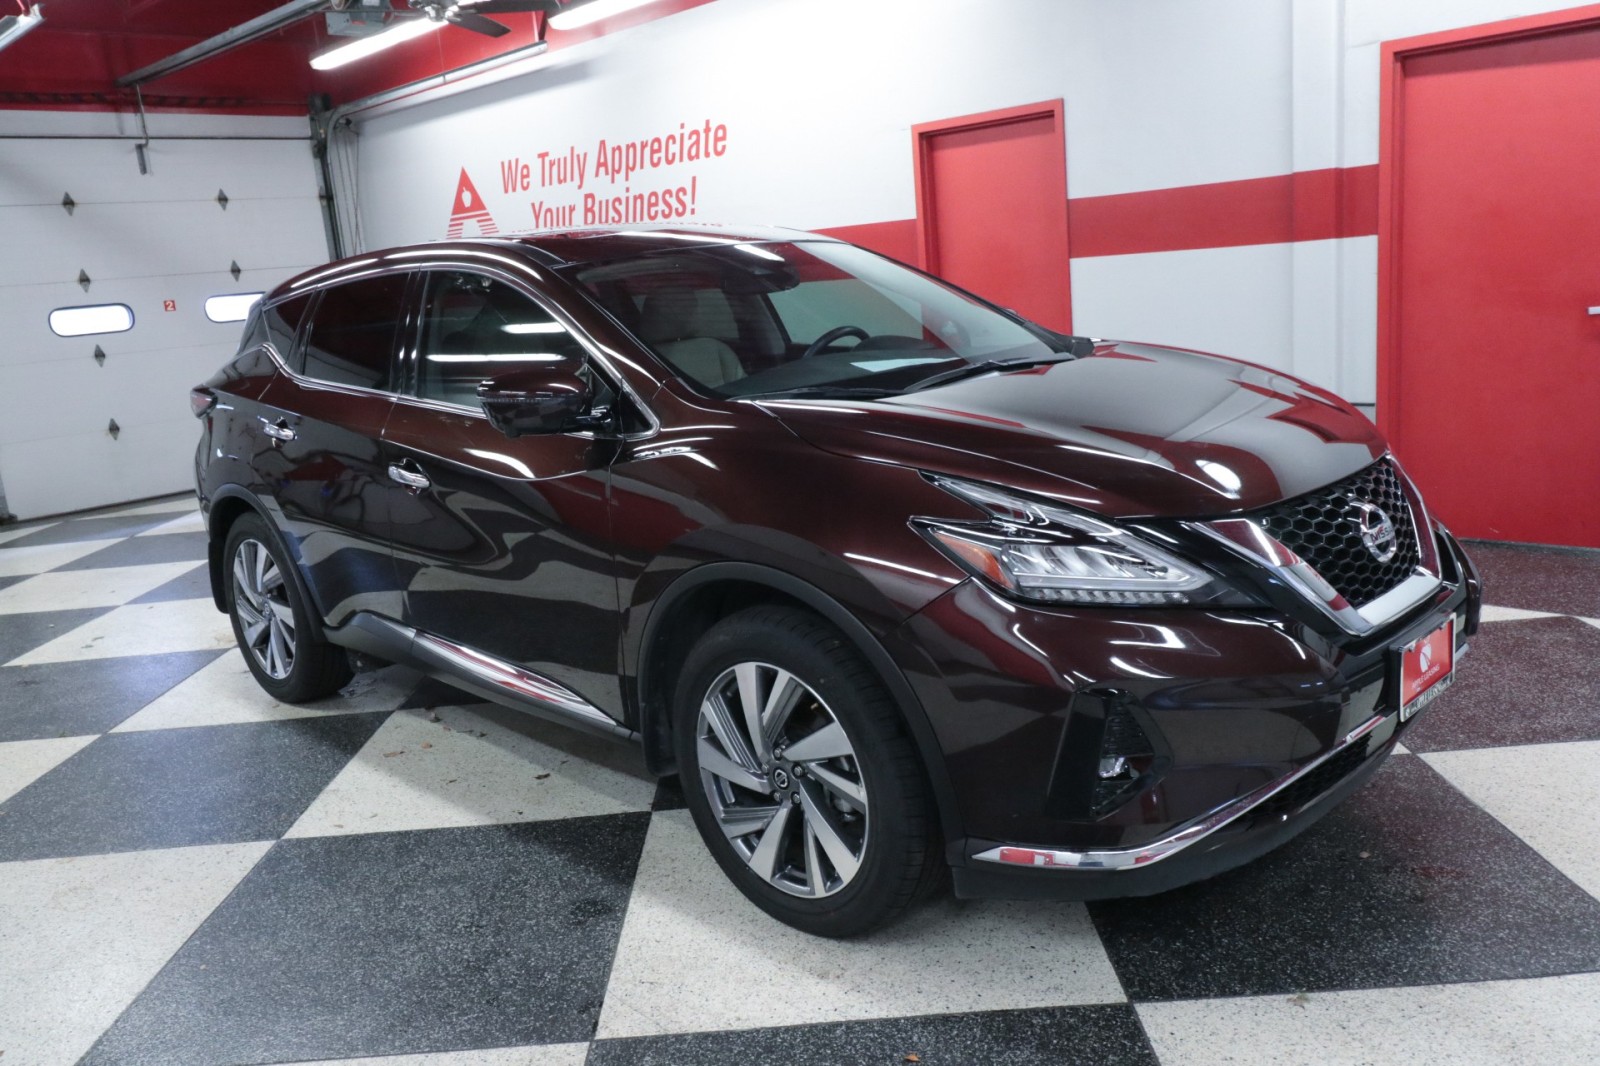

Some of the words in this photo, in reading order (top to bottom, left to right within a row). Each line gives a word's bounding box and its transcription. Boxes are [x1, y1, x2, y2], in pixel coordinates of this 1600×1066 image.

[501, 159, 531, 195] We
[537, 147, 589, 190] Truly
[594, 119, 728, 185] Appreciate
[531, 202, 577, 230] Your
[583, 175, 698, 226] Business!
